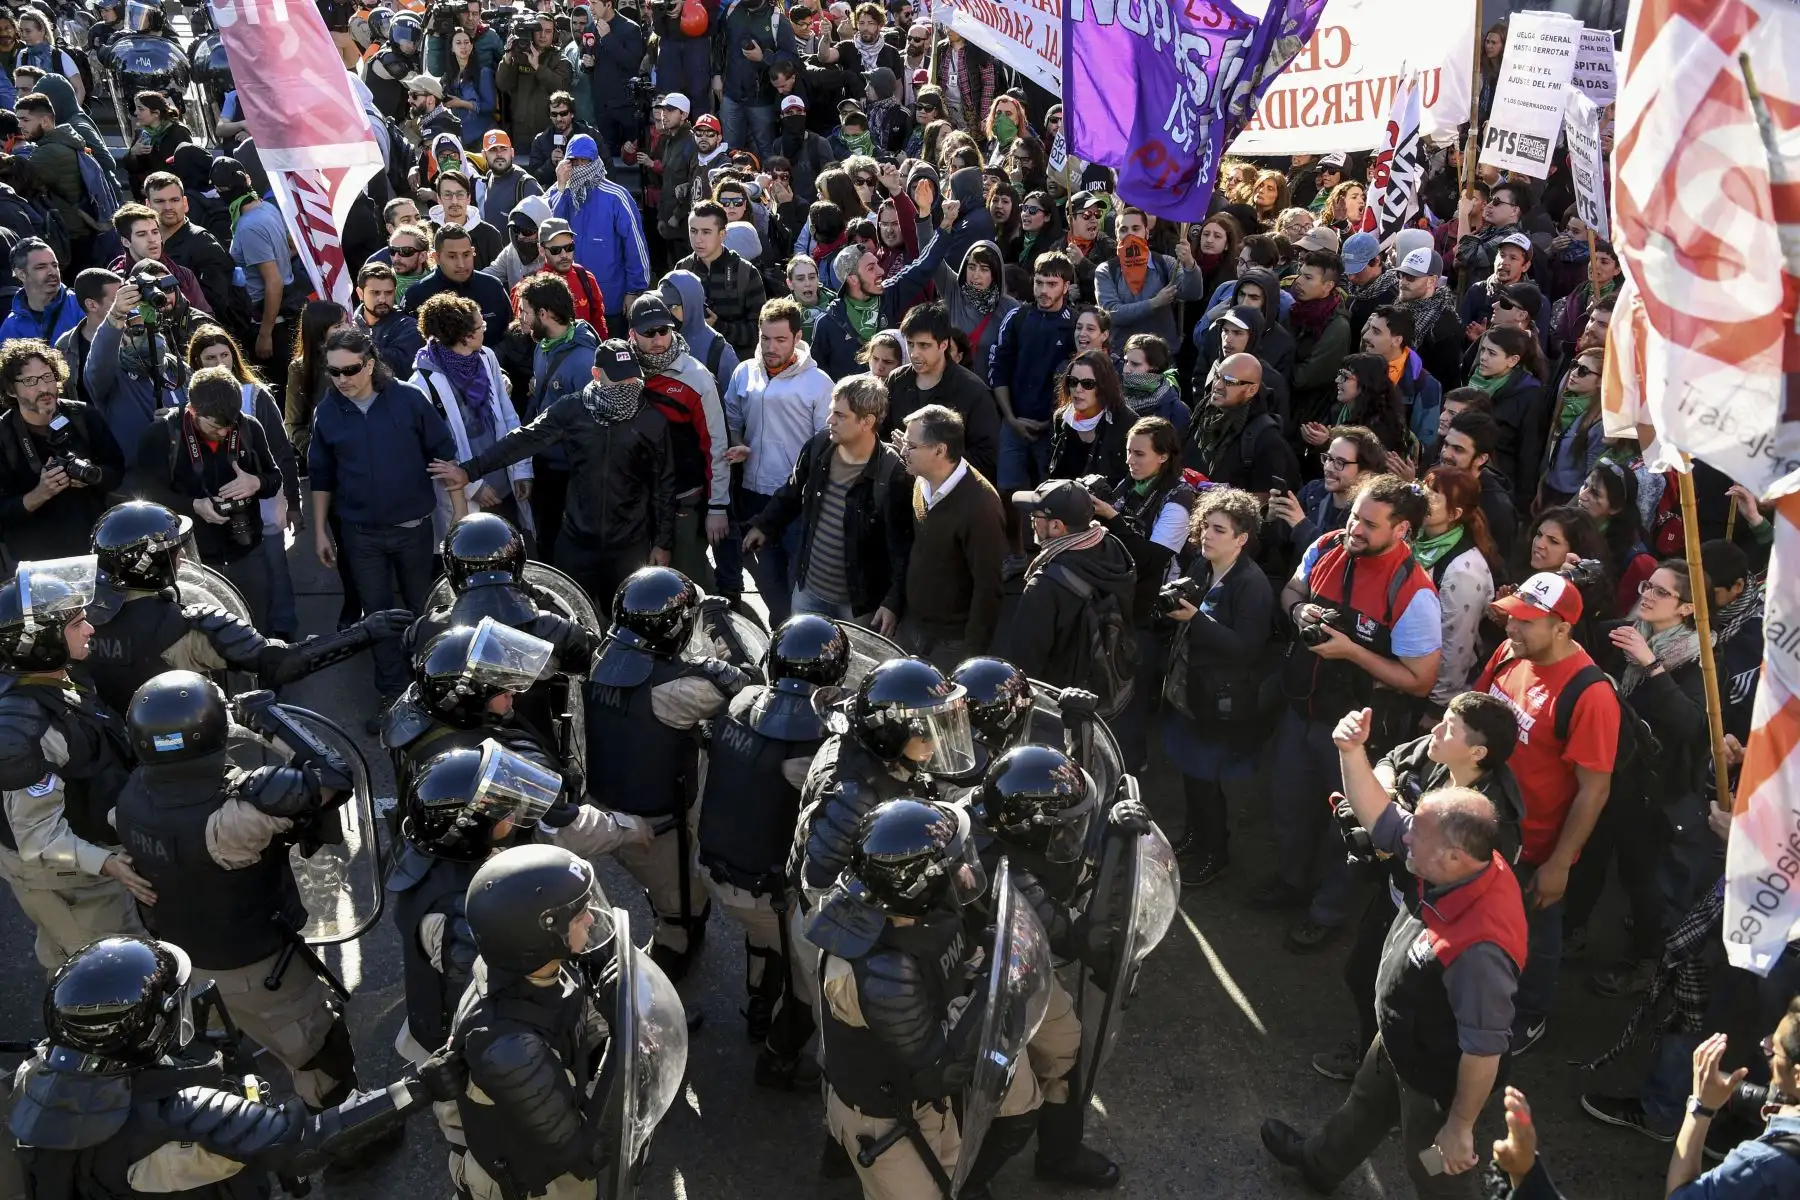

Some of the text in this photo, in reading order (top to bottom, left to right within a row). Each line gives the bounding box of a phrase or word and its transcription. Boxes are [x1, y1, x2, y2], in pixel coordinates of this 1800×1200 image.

[1540, 34, 1572, 44] GENERAL
[1532, 47, 1570, 57] DERROTAR
[1543, 67, 1552, 76] EL
[1532, 79, 1546, 89] DEL
[1547, 82, 1563, 91] FMI
[1485, 126, 1518, 155] PTS
[1085, 180, 1107, 191] LUCKY
[1535, 580, 1550, 595] LA
[88, 638, 123, 659] PNA
[591, 686, 621, 709] PNA
[939, 931, 964, 980] PNA
